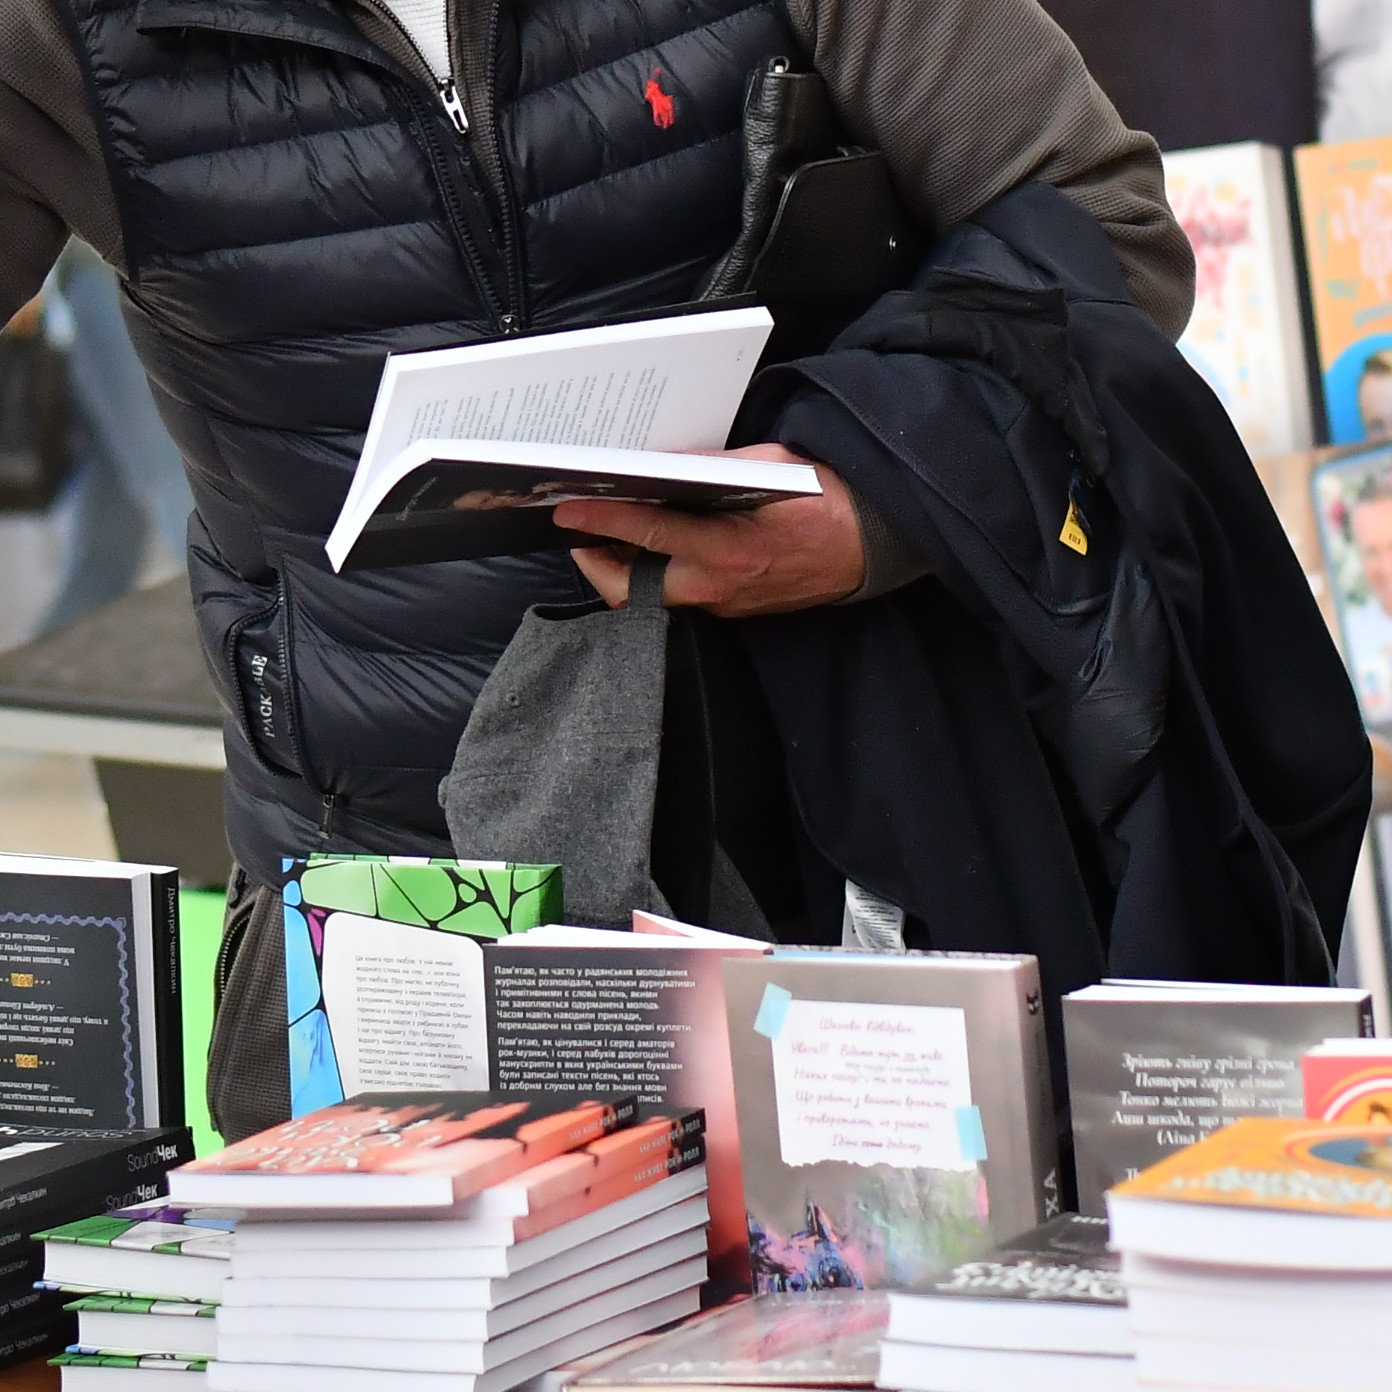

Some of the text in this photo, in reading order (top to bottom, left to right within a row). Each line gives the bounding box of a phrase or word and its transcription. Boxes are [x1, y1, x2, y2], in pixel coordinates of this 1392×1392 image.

[551, 968, 574, 976] часто
[577, 969, 582, 978] у
[497, 1010, 523, 1019] Часом
[526, 1011, 551, 1019] навіть
[554, 1012, 596, 1020] наводили
[574, 1022, 591, 1031] свій
[594, 1023, 623, 1032] розсуд
[625, 1023, 654, 1032] окремі
[610, 1040, 634, 1049] серед
[637, 1040, 675, 1049] аматорів
[557, 1050, 582, 1060] серед
[647, 1061, 683, 1071] буквами
[562, 1072, 589, 1080] тексти
[623, 1073, 634, 1081] які
[578, 1083, 593, 1091] але
[645, 1084, 667, 1092] мови
